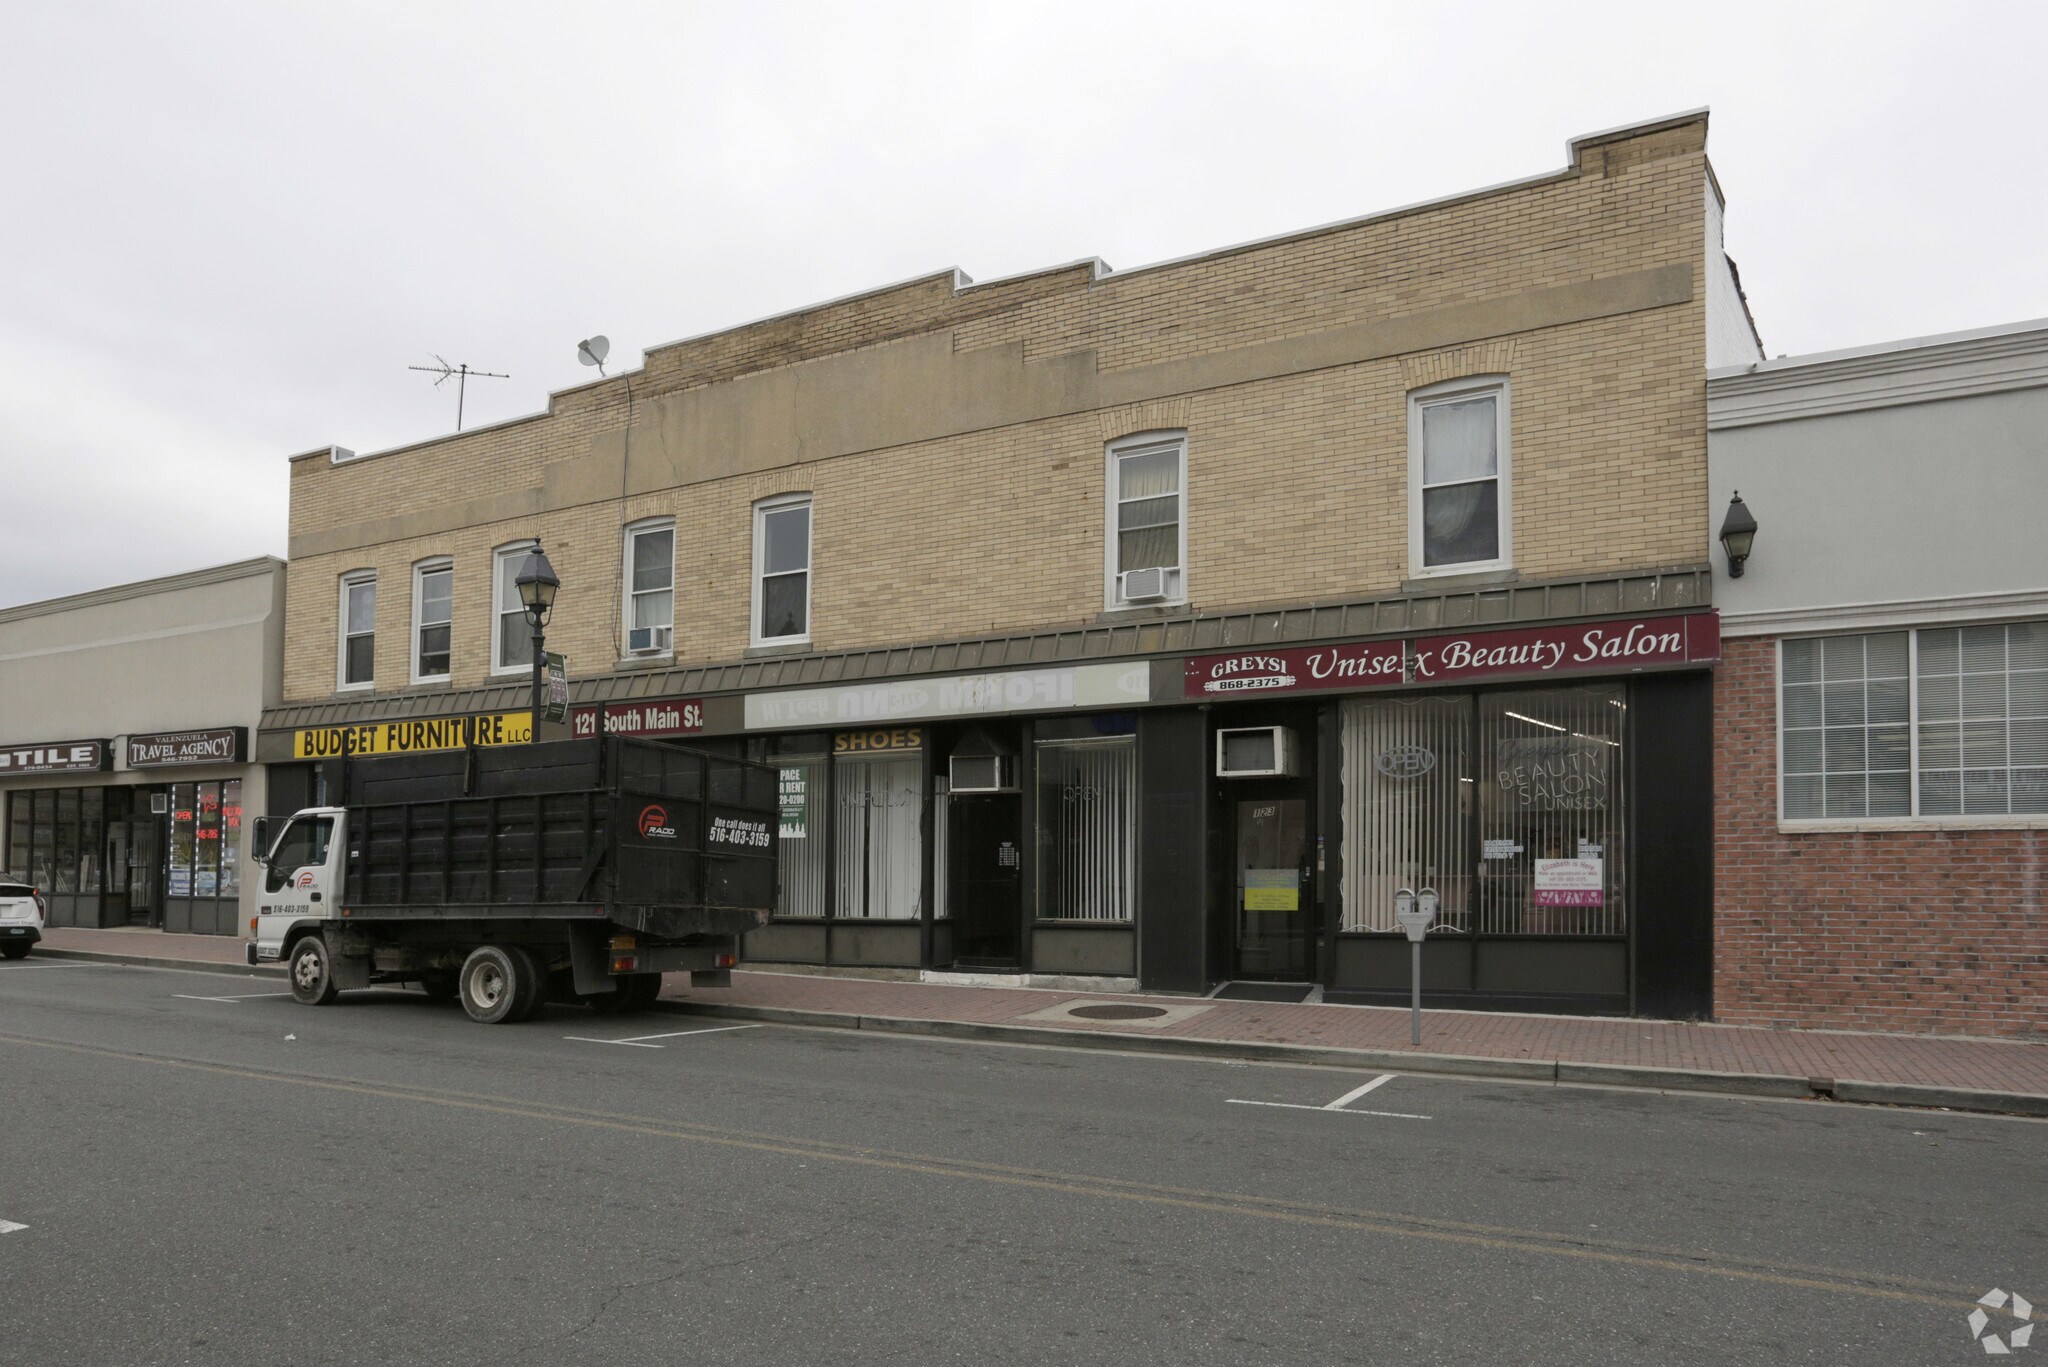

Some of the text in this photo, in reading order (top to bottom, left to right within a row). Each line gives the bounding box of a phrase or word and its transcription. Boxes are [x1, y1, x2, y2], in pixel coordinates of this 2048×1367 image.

[1306, 624, 1682, 679] Unisex Beauty Salon
[1211, 656, 1287, 678] GREYSI
[1219, 677, 1280, 690] 868-2375
[575, 705, 703, 734] 121 South Main St.
[156, 733, 208, 743] VALENZUELA
[303, 716, 531, 756] BUDGET FURNITURE LLC
[835, 728, 921, 751] SHOES
[132, 736, 230, 762] TRAVEL AGENCY
[1380, 752, 1431, 771] OPEN
[1499, 749, 1599, 789] BEAUTY
[780, 769, 800, 781] PACE
[786, 782, 805, 793] RENT
[1519, 769, 1606, 805] SALON
[779, 795, 804, 804] 20-0200
[1545, 795, 1606, 811] UNISEX
[1253, 806, 1275, 818] 123
[714, 817, 767, 832] One call does it all
[709, 827, 770, 847] 516-403-3159
[1541, 861, 1570, 872] Elizabeth
[1580, 861, 1595, 871] Here
[273, 905, 309, 914] 516-403-3159
